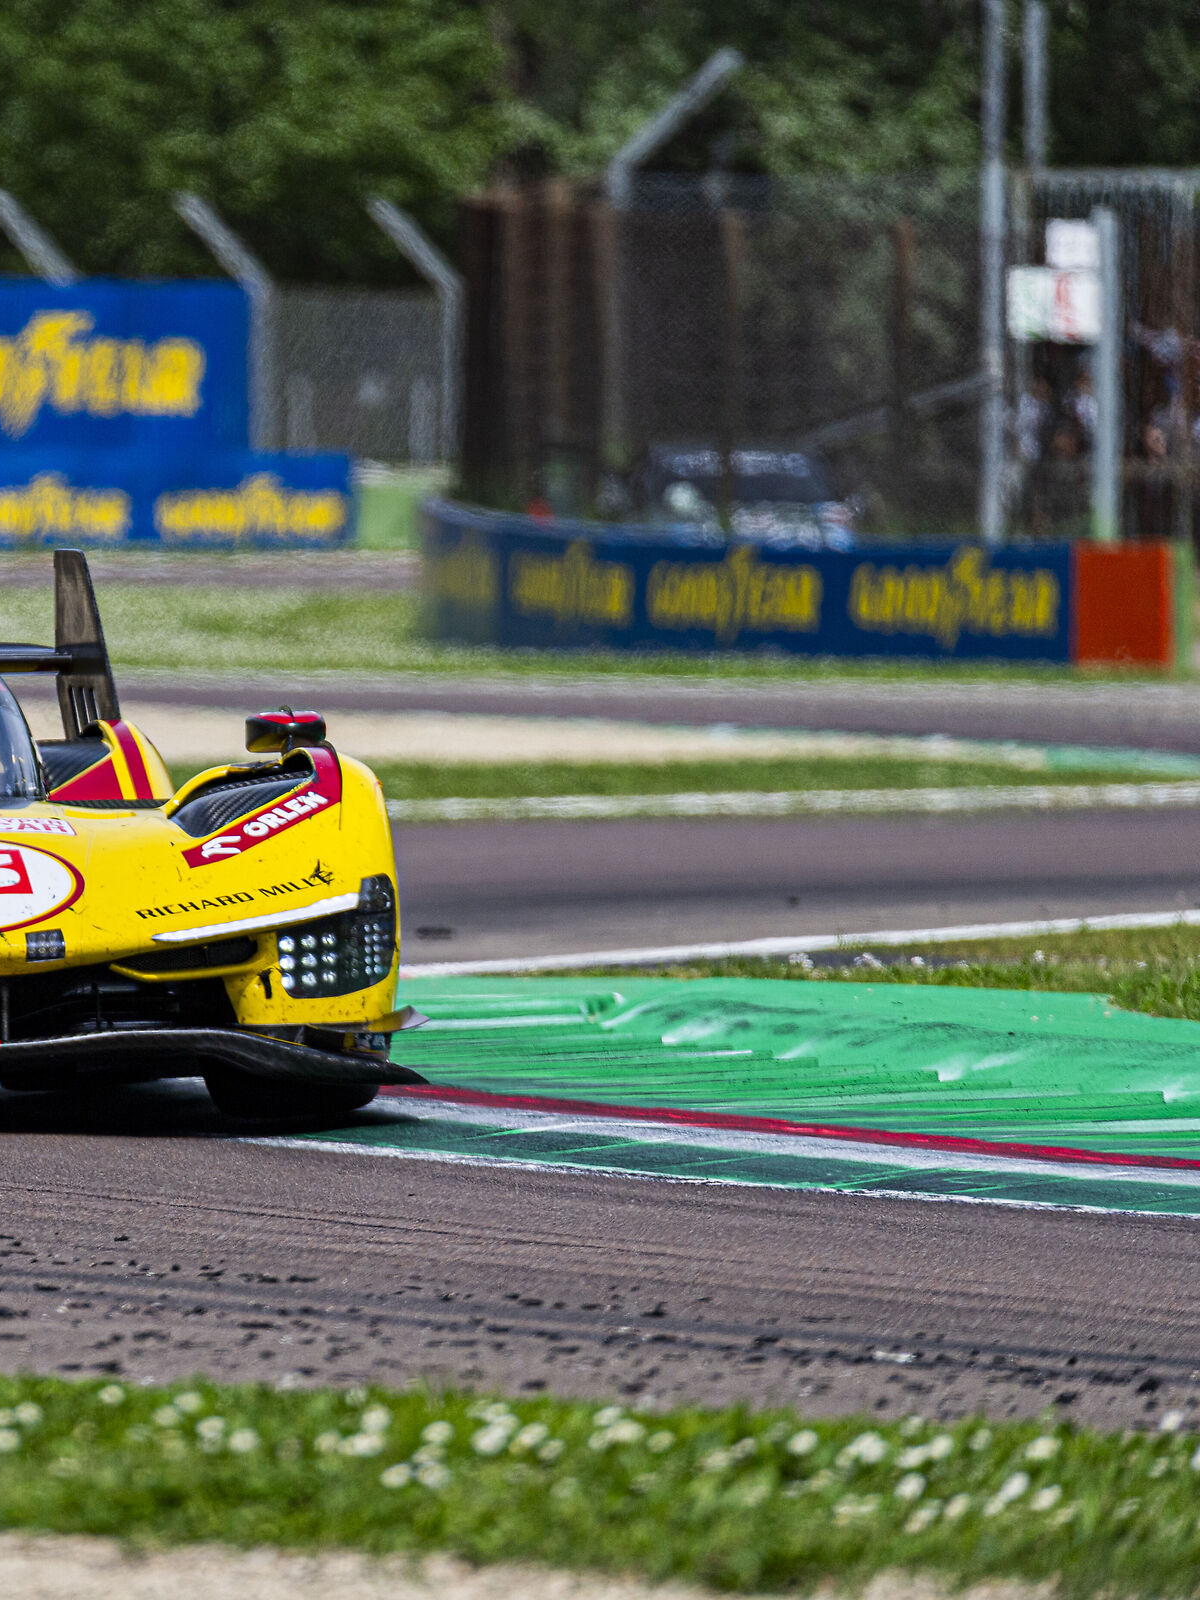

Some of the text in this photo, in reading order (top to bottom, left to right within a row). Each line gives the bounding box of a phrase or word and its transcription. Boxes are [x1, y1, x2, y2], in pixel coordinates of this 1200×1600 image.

[242, 790, 329, 838] ORLEN
[135, 870, 335, 920] RICHARD MILLE
